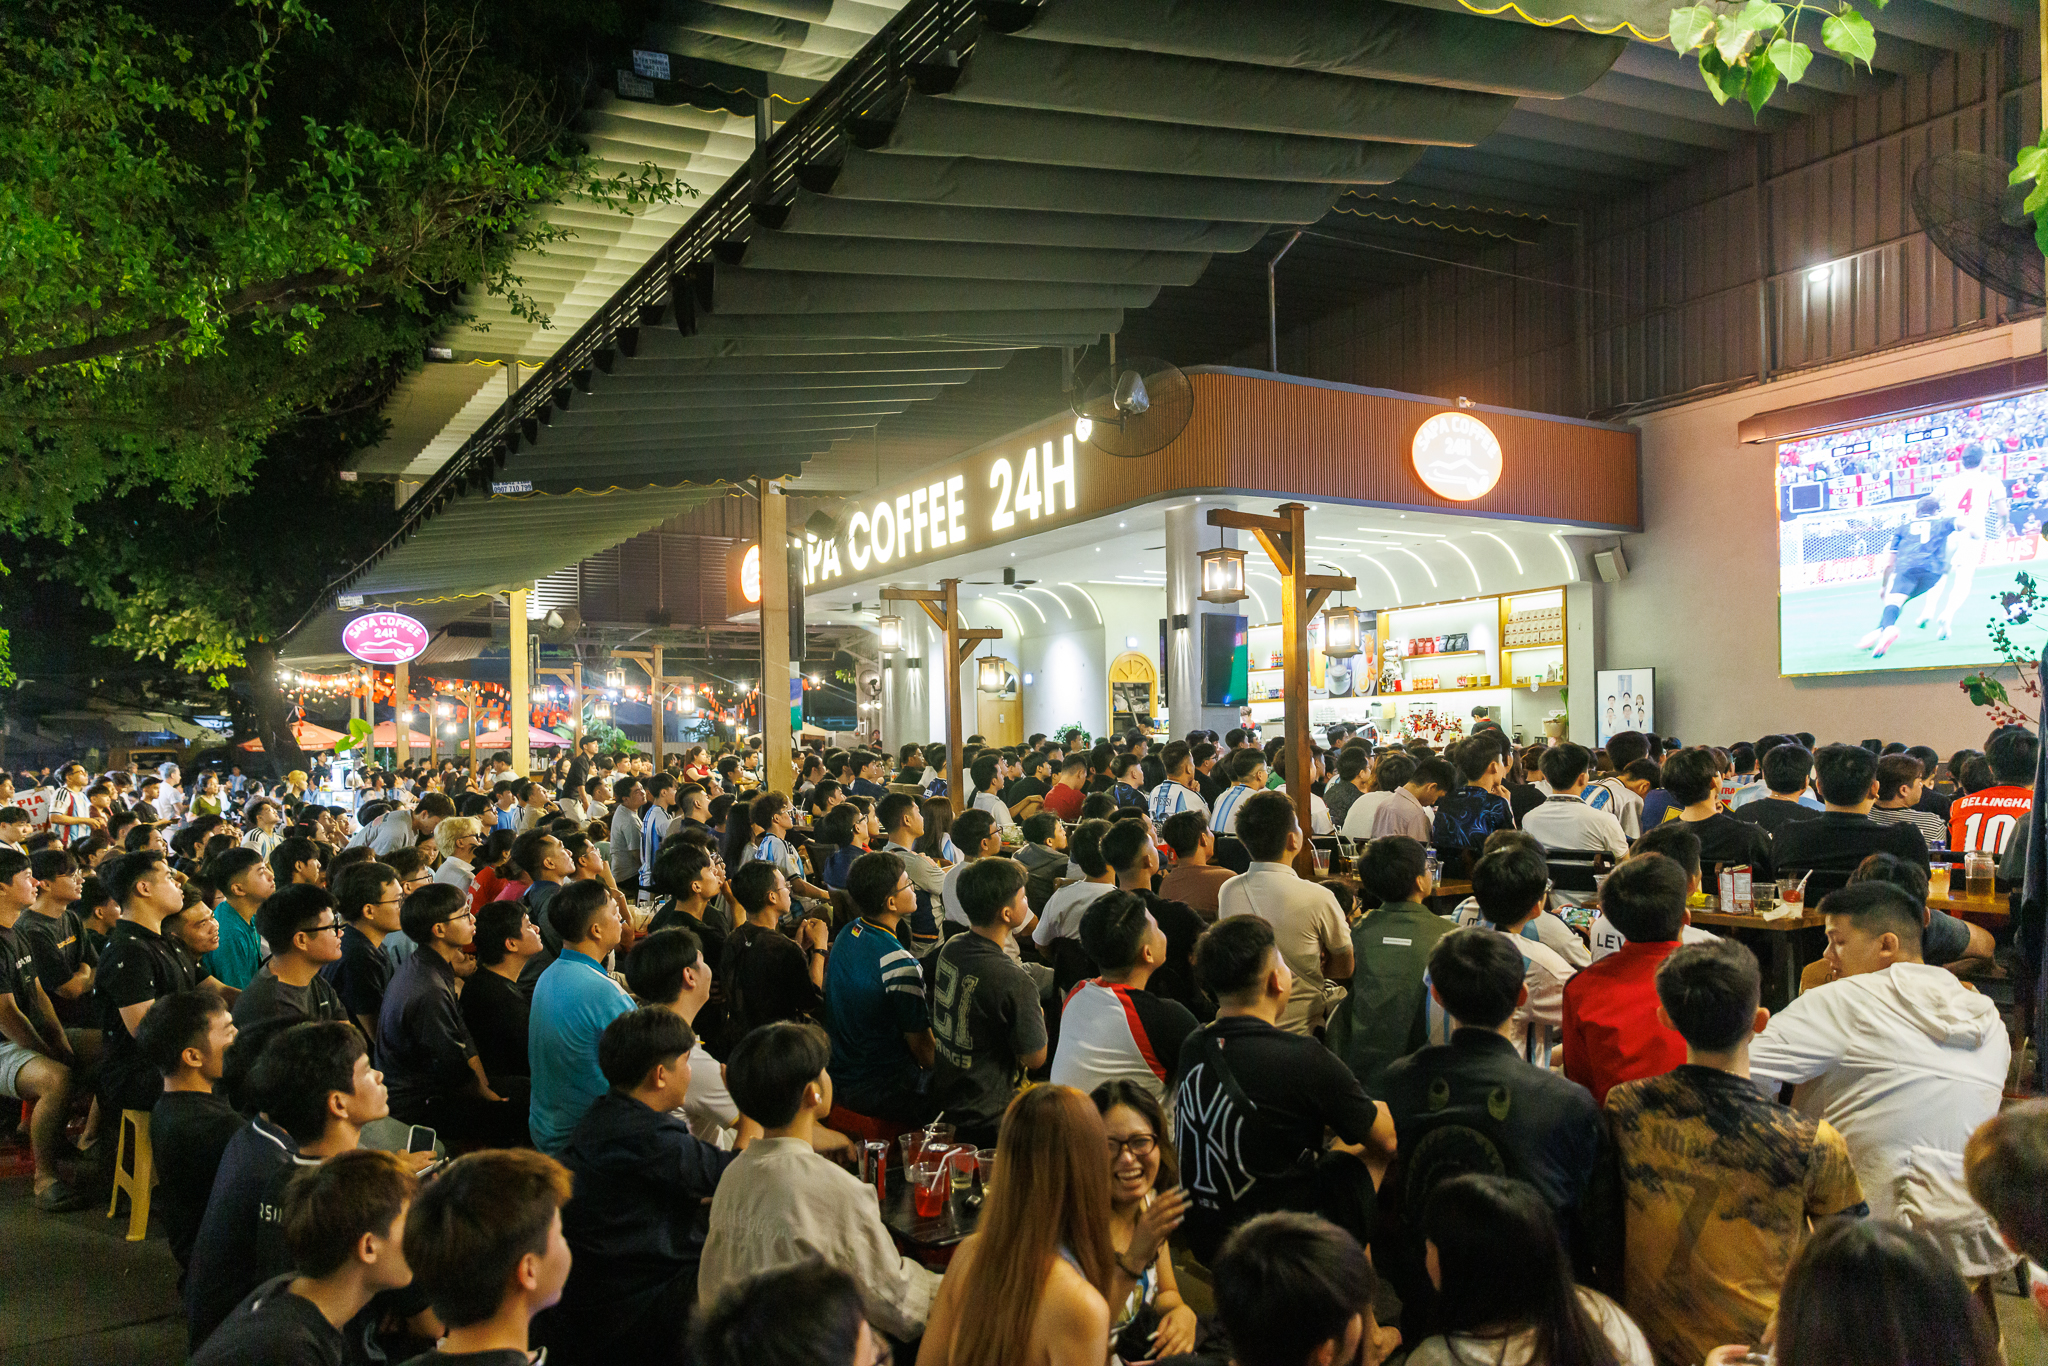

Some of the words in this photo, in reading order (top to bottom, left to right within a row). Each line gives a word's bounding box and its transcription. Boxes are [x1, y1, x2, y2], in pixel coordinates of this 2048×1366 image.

[1416, 417, 1450, 452] SAPA
[1451, 416, 1499, 459] COFFEE
[1444, 437, 1472, 457] 24H
[848, 473, 967, 573] COFFEE
[989, 433, 1077, 532] 24H
[1958, 488, 1973, 513] 4
[1910, 521, 1931, 544] 9
[348, 617, 377, 639] SAPA
[379, 616, 423, 638] COFFEE
[374, 627, 398, 638] 24H
[1964, 812, 2019, 855] 10
[933, 956, 979, 1050] 21
